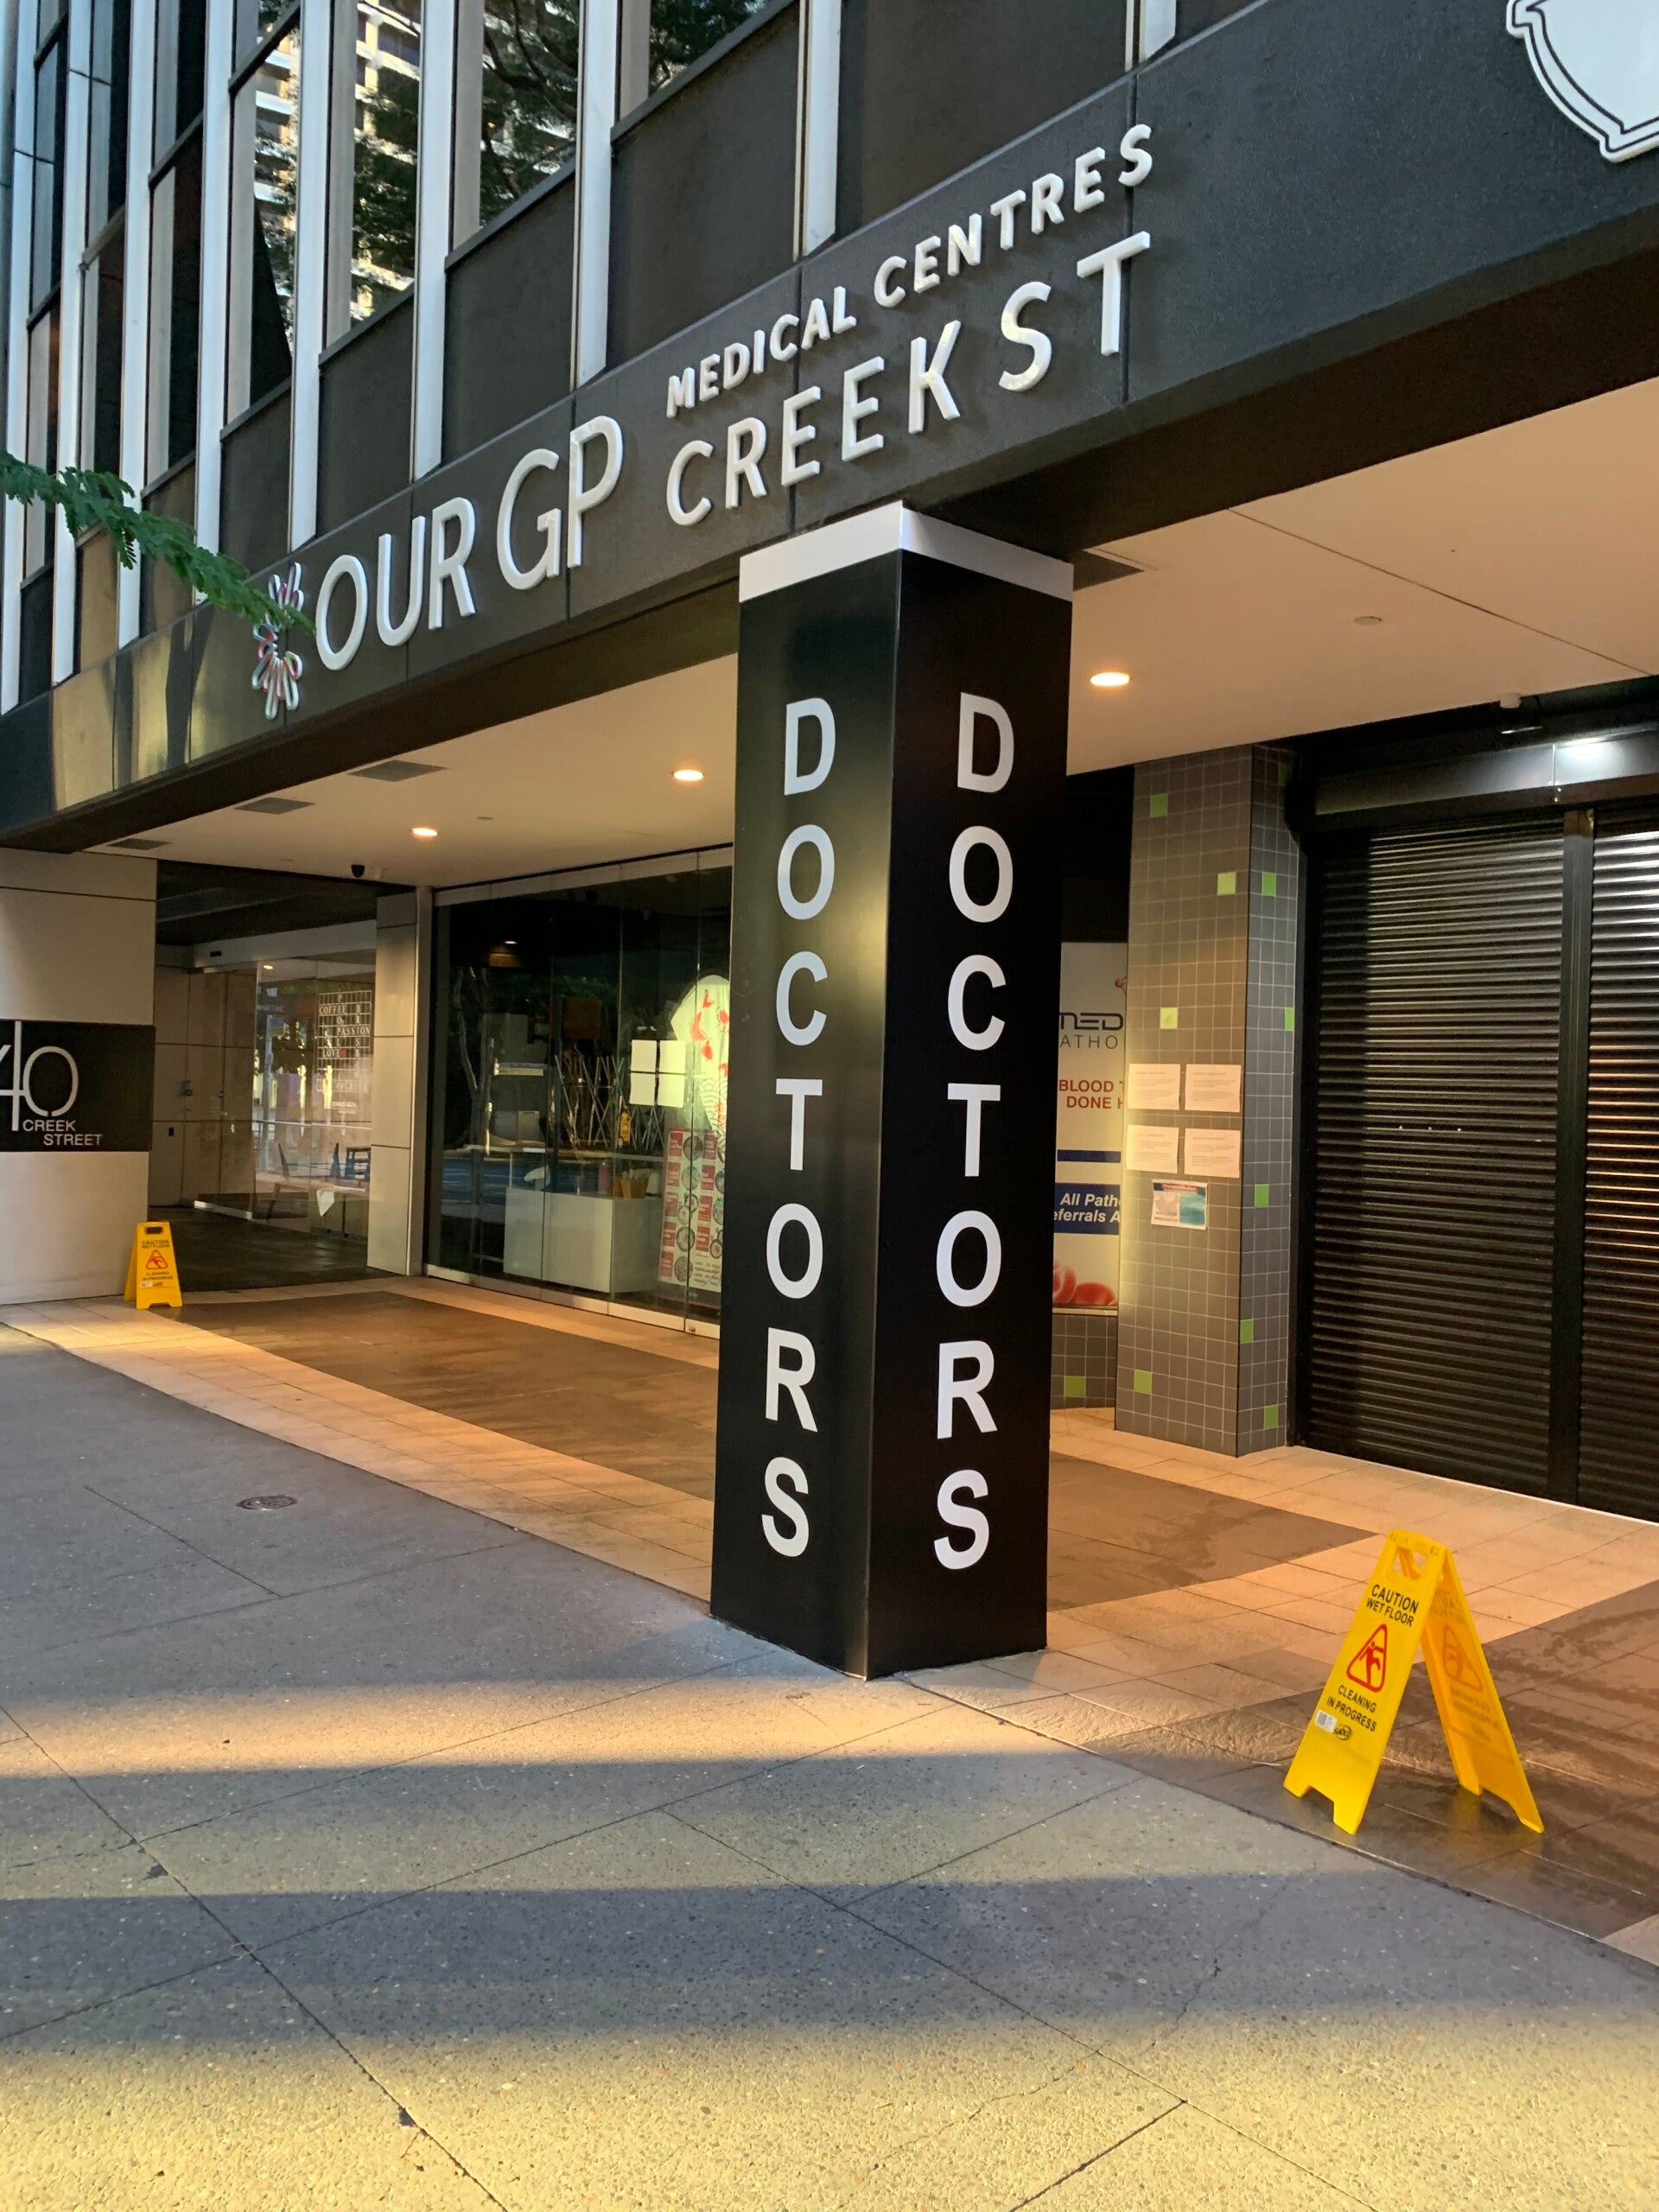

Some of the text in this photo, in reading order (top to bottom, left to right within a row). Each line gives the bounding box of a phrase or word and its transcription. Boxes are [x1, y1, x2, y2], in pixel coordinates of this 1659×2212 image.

[666, 123, 1154, 419] MEDICAL CENTRES
[666, 230, 1152, 526] CREEK ST
[315, 415, 623, 671] OUR GP
[319, 1004, 346, 1015] COFFEE
[336, 1026, 371, 1037] PASSION
[321, 1047, 340, 1058] LOVE
[0, 1020, 79, 1132] 40
[1058, 1079, 1115, 1092] BLOOD
[1066, 1096, 1112, 1109] DONE
[22, 1119, 77, 1132] CREEK
[762, 697, 836, 1557] DOCTORS
[934, 692, 1014, 1570] DOCTORS
[43, 1134, 102, 1146] STREET
[1059, 1192, 1121, 1207] All Path
[1366, 1598, 1384, 1614] WET
[1384, 1606, 1414, 1626] FLOOR
[1371, 1584, 1419, 1614] CAUTION
[1338, 1684, 1377, 1713] CLEANING
[1326, 1695, 1336, 1707] IN
[1333, 1700, 1377, 1732] PROGRESS
